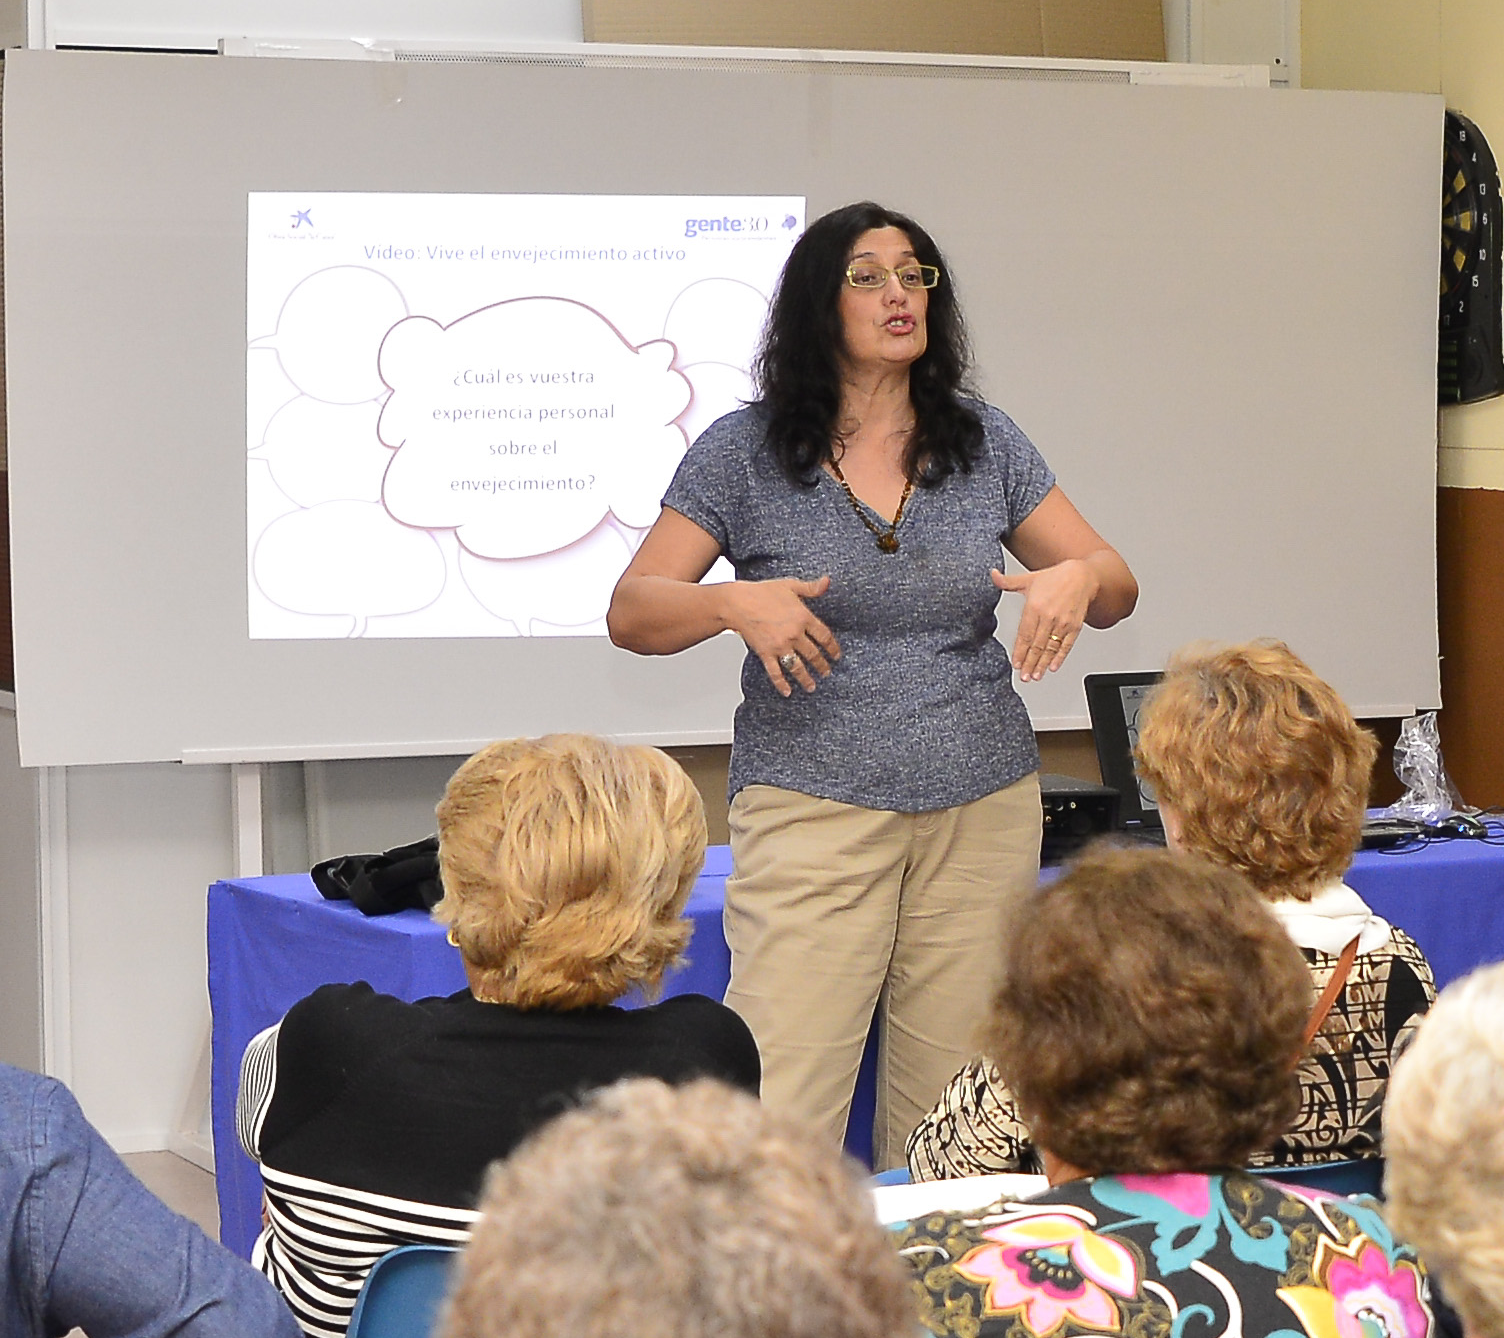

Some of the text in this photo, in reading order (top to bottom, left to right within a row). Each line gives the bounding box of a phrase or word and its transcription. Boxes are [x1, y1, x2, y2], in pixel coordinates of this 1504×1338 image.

[427, 244, 464, 260] Vive
[470, 244, 484, 260] el
[491, 244, 628, 264] envejecimiento
[633, 244, 686, 261] activo
[453, 368, 594, 387] ¿Cuál es vuestra
[432, 403, 614, 423] experiencia personal
[489, 439, 557, 456] sobre el
[450, 474, 596, 495] envejecimiento?
